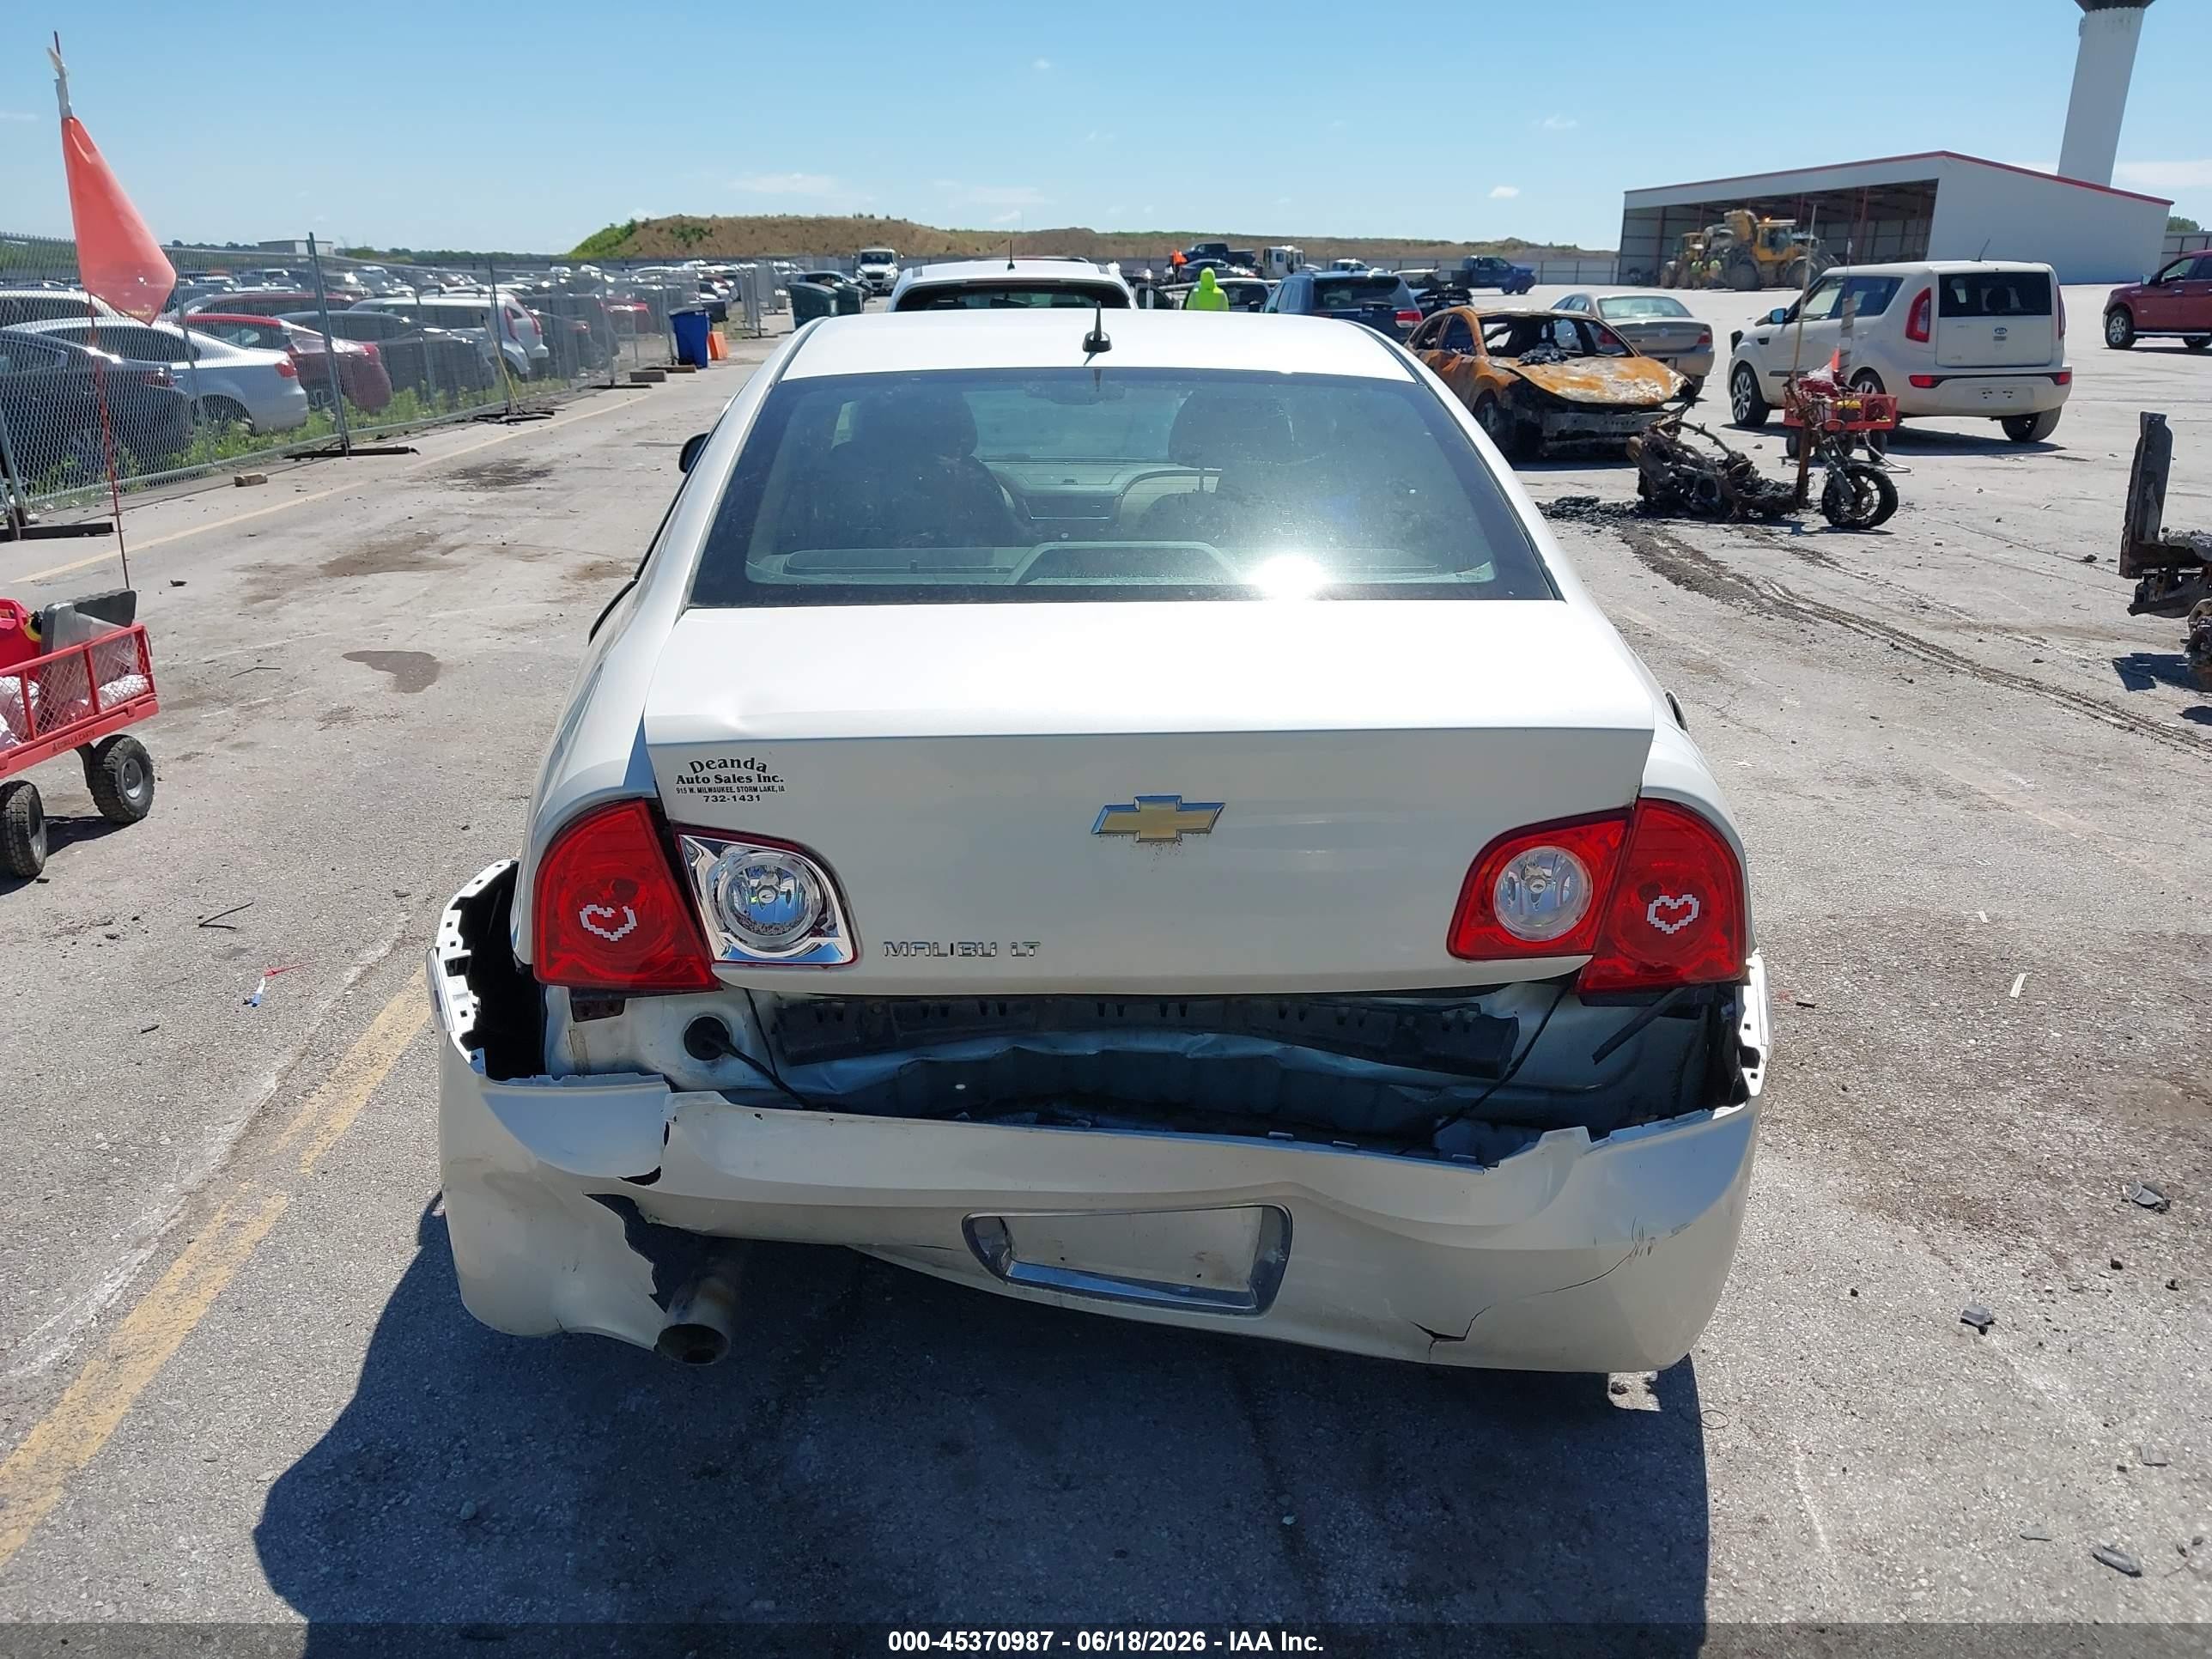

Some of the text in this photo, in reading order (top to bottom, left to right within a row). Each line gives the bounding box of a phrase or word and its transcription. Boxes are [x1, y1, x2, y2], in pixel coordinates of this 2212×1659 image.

[689, 757, 768, 775] Deanda
[676, 773, 784, 785] Auto Sales Inc.
[703, 794, 761, 803] 732-1431
[883, 941, 1041, 957] MALIBU LT
